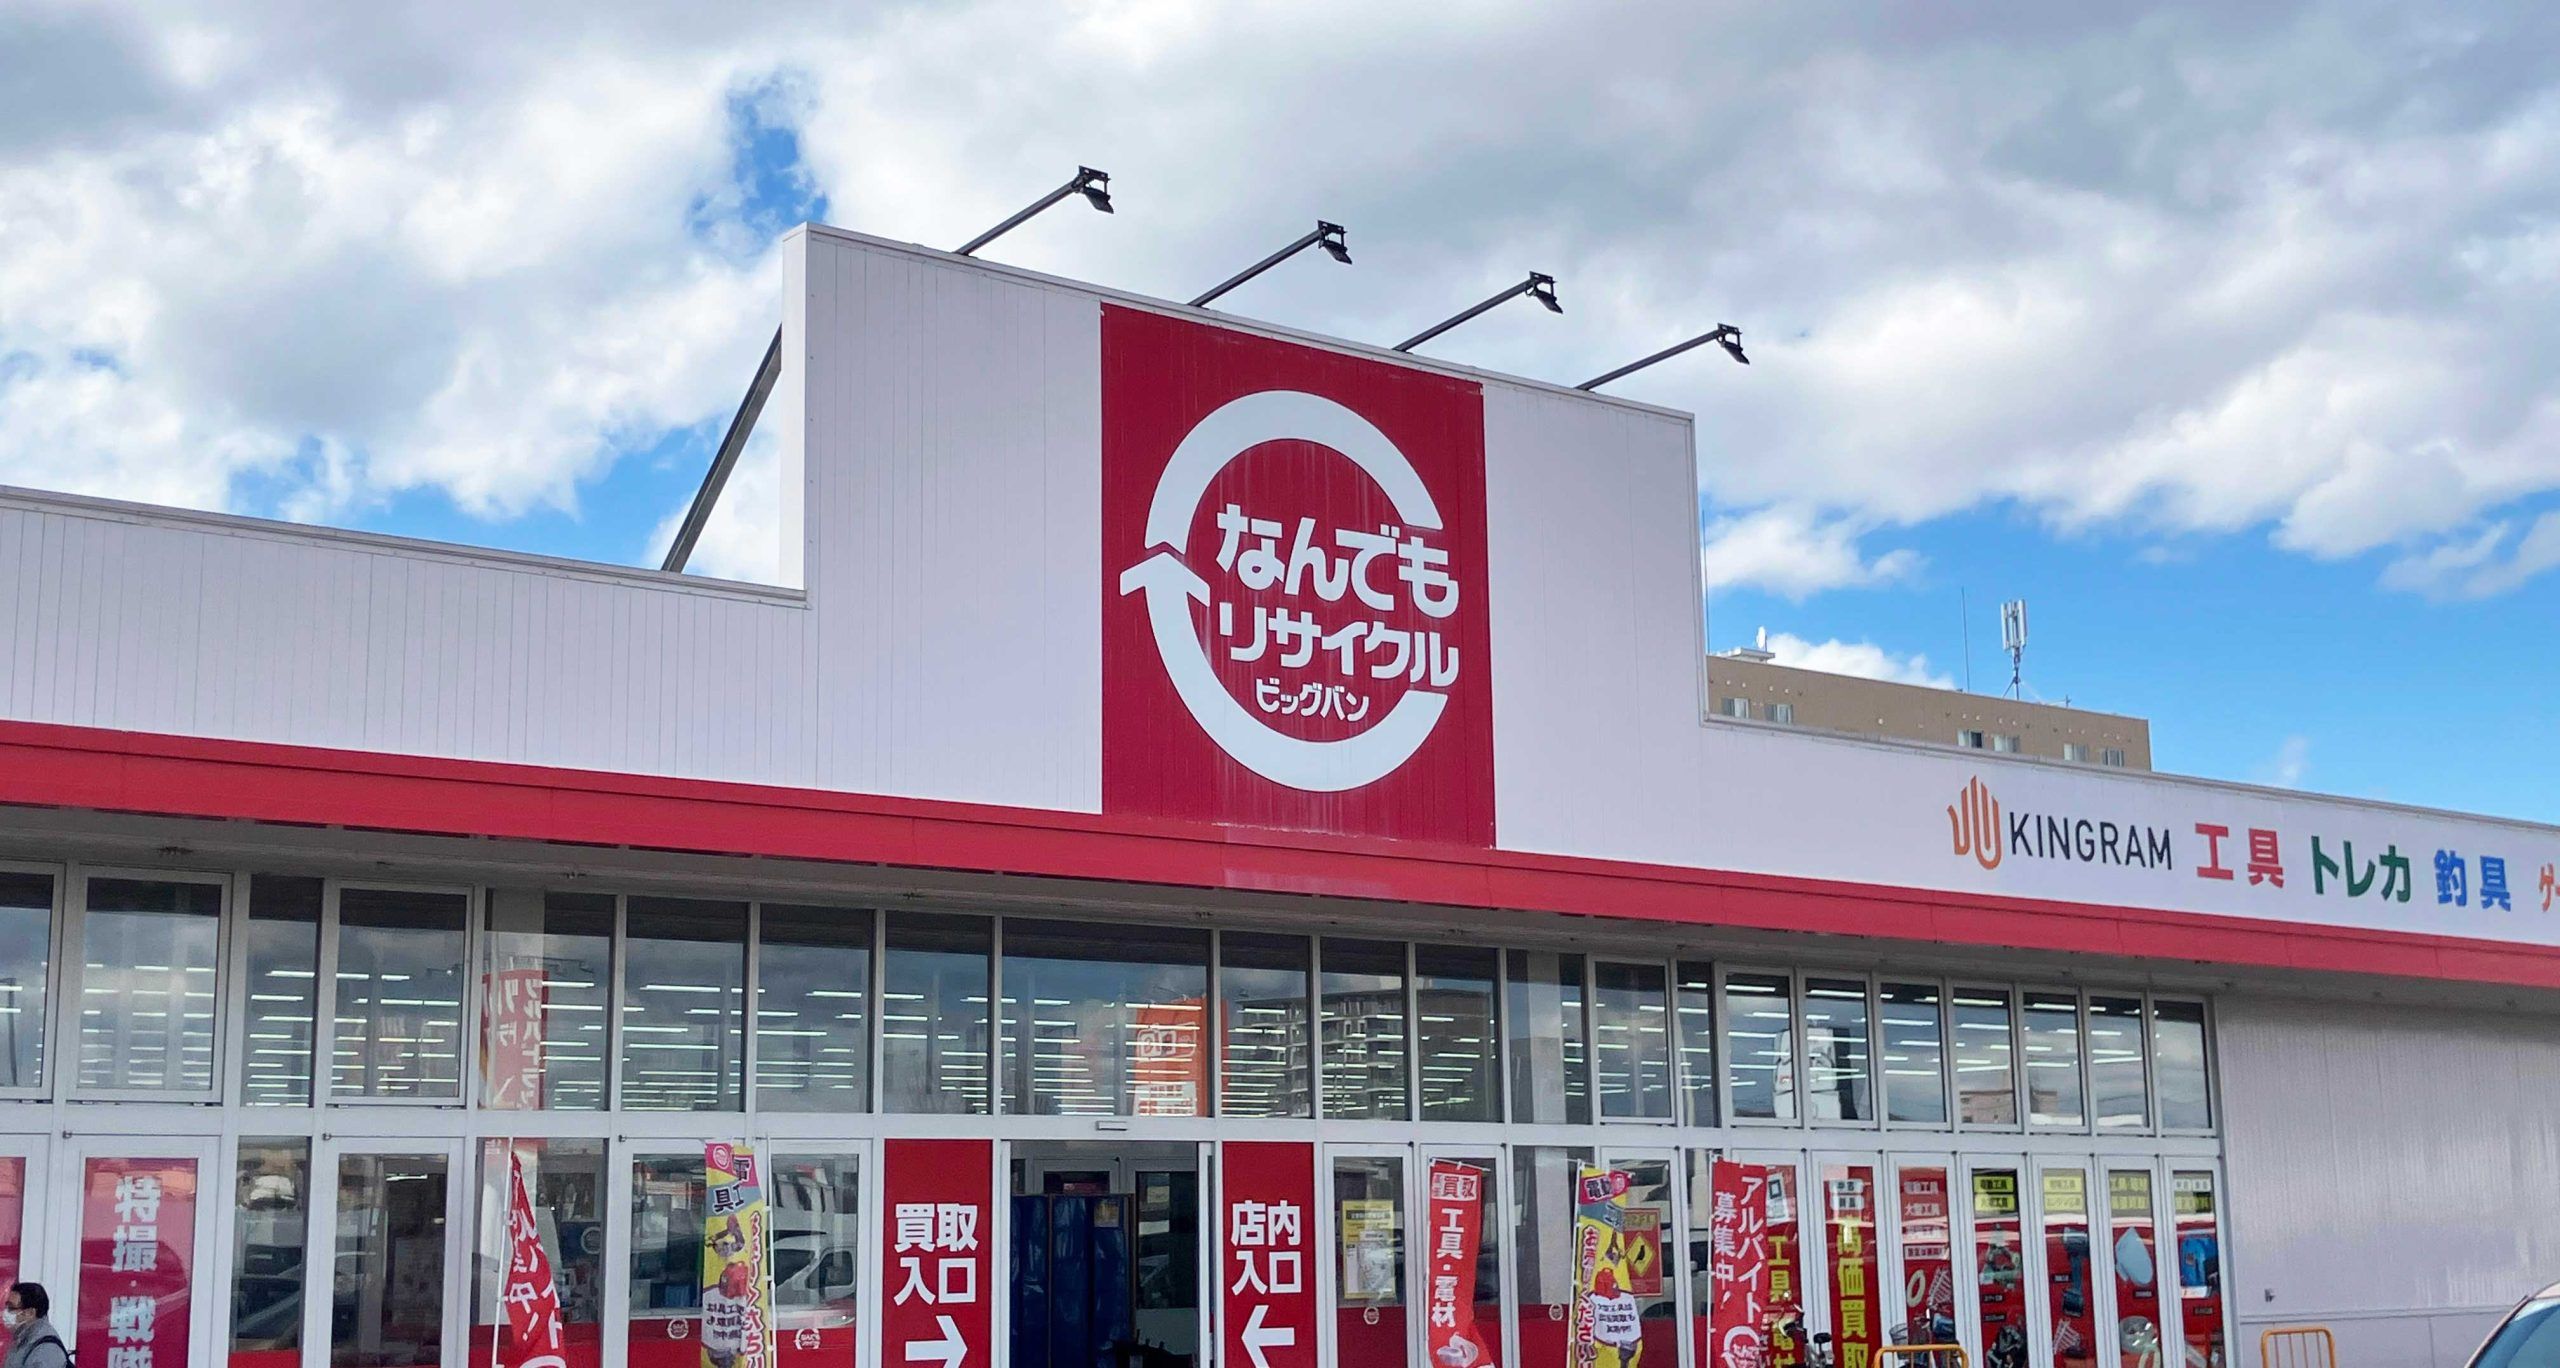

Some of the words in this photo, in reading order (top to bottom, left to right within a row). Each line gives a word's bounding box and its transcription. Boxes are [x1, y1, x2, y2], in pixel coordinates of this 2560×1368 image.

[1216, 504, 1460, 618] なんでも
[1219, 602, 1460, 688] リサイクル
[1255, 677, 1370, 723] ビッグバン
[2009, 810, 2173, 871] KINGRAM
[2195, 821, 2286, 890] 工具
[2311, 834, 2412, 905] トレカ
[2433, 847, 2513, 913] 釣具
[894, 1202, 978, 1254] 買取
[1231, 1199, 1302, 1247] 店内
[1736, 1175, 1766, 1324] アルバイト
[893, 1256, 977, 1307] 入口
[1231, 1251, 1302, 1296] 入口
[1431, 1207, 1465, 1329] 工具・電材
